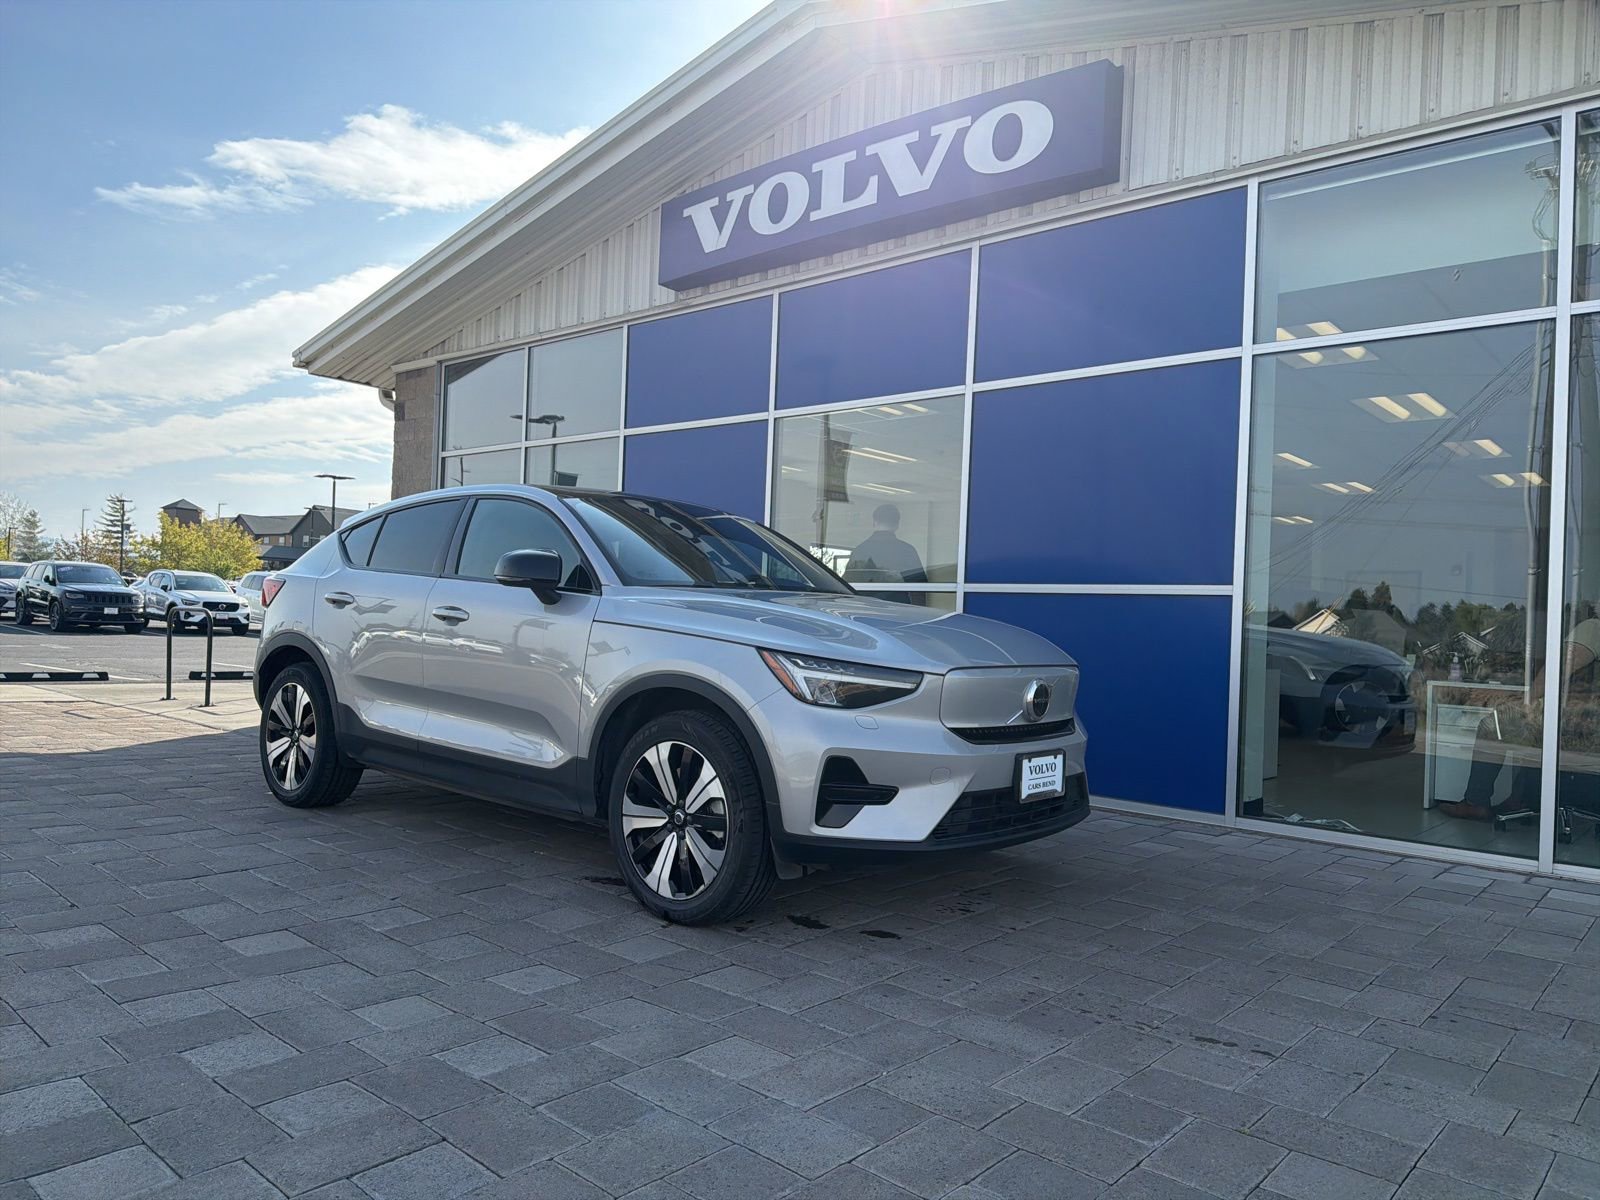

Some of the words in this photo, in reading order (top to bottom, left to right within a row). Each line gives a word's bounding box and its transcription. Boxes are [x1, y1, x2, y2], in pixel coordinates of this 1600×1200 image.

[682, 100, 1054, 254] VOLVO
[1028, 762, 1057, 776] VOLVO
[1027, 783, 1042, 791] CARS
[1042, 780, 1056, 788] BEND
